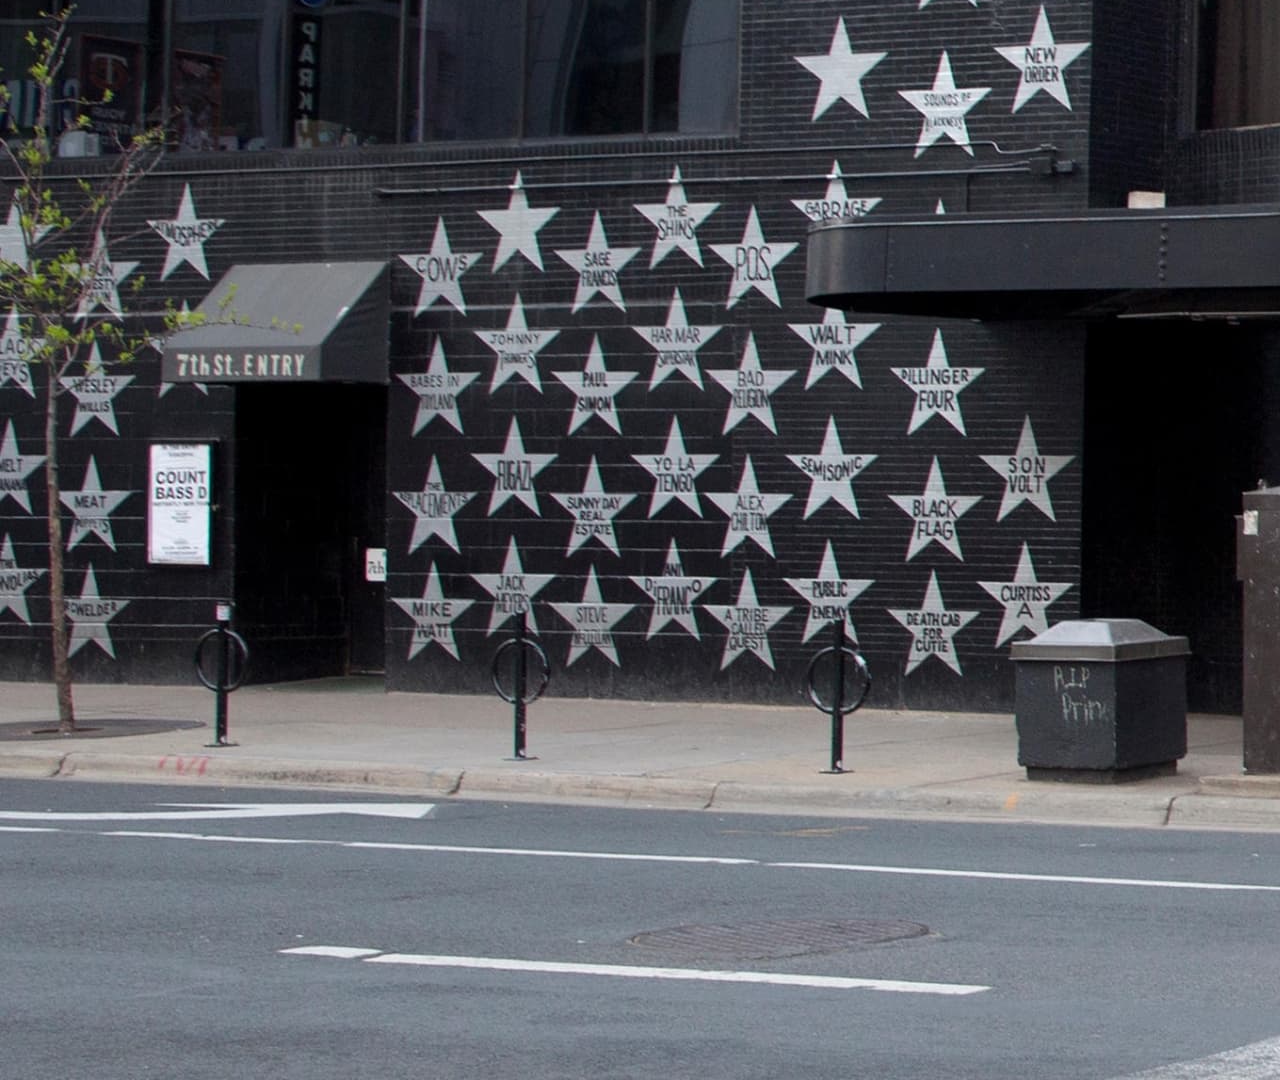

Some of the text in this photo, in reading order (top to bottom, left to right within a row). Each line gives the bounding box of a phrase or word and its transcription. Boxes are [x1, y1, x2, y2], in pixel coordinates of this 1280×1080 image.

[1025, 47, 1057, 64] NEW
[1024, 66, 1060, 83] ORDER
[924, 92, 959, 107] SOUNDS
[666, 204, 688, 217] THE
[657, 218, 696, 240] SHINS
[584, 252, 612, 267] SAGE
[416, 254, 468, 282] COWS
[581, 270, 618, 287] FRANCIS
[490, 333, 541, 345] JOHNNY
[651, 327, 700, 344] HAR MAR
[177, 353, 305, 378] 7th St. ENTRY
[816, 350, 852, 366] MINK
[410, 374, 459, 387] BABES IN
[582, 372, 609, 387] PAUL
[737, 370, 765, 387] BAD
[901, 369, 970, 385] DILLINGER
[73, 377, 117, 394] WESLEY
[79, 401, 110, 413] WILLIS
[577, 396, 612, 412] SIMON
[918, 390, 955, 411] FOUR
[654, 457, 696, 471] YO LA
[801, 456, 862, 482] SEMISONIC
[1008, 457, 1046, 474] SON
[155, 471, 206, 484] COUNT
[497, 460, 533, 491] FUGAZI
[657, 473, 694, 493] TENGO
[427, 482, 441, 491] THE
[1008, 475, 1044, 493] VOLT
[74, 495, 107, 508] MEAT
[155, 487, 207, 500] BASS D
[567, 496, 622, 510] SUNNY DAY
[736, 495, 764, 511] ALEX
[913, 498, 960, 520] BLACK
[580, 511, 605, 522] REAL
[731, 512, 767, 532] CHILTON
[575, 523, 612, 535] ESTATE
[917, 521, 953, 541] FLAG
[496, 575, 526, 591] JACK
[812, 581, 848, 598] PUBLIC
[1001, 585, 1051, 602] CURTISS
[412, 602, 452, 617] MIKE
[576, 607, 608, 623] STEVE
[724, 609, 733, 621] A
[811, 605, 847, 621] ENEMY
[1016, 603, 1034, 619] A
[907, 611, 961, 627] DEATH CAB
[416, 623, 448, 638] WATT
[732, 622, 767, 635] CALLED
[923, 627, 943, 641] FOR
[728, 636, 765, 651] QUEST
[915, 639, 948, 653] CUTIE
